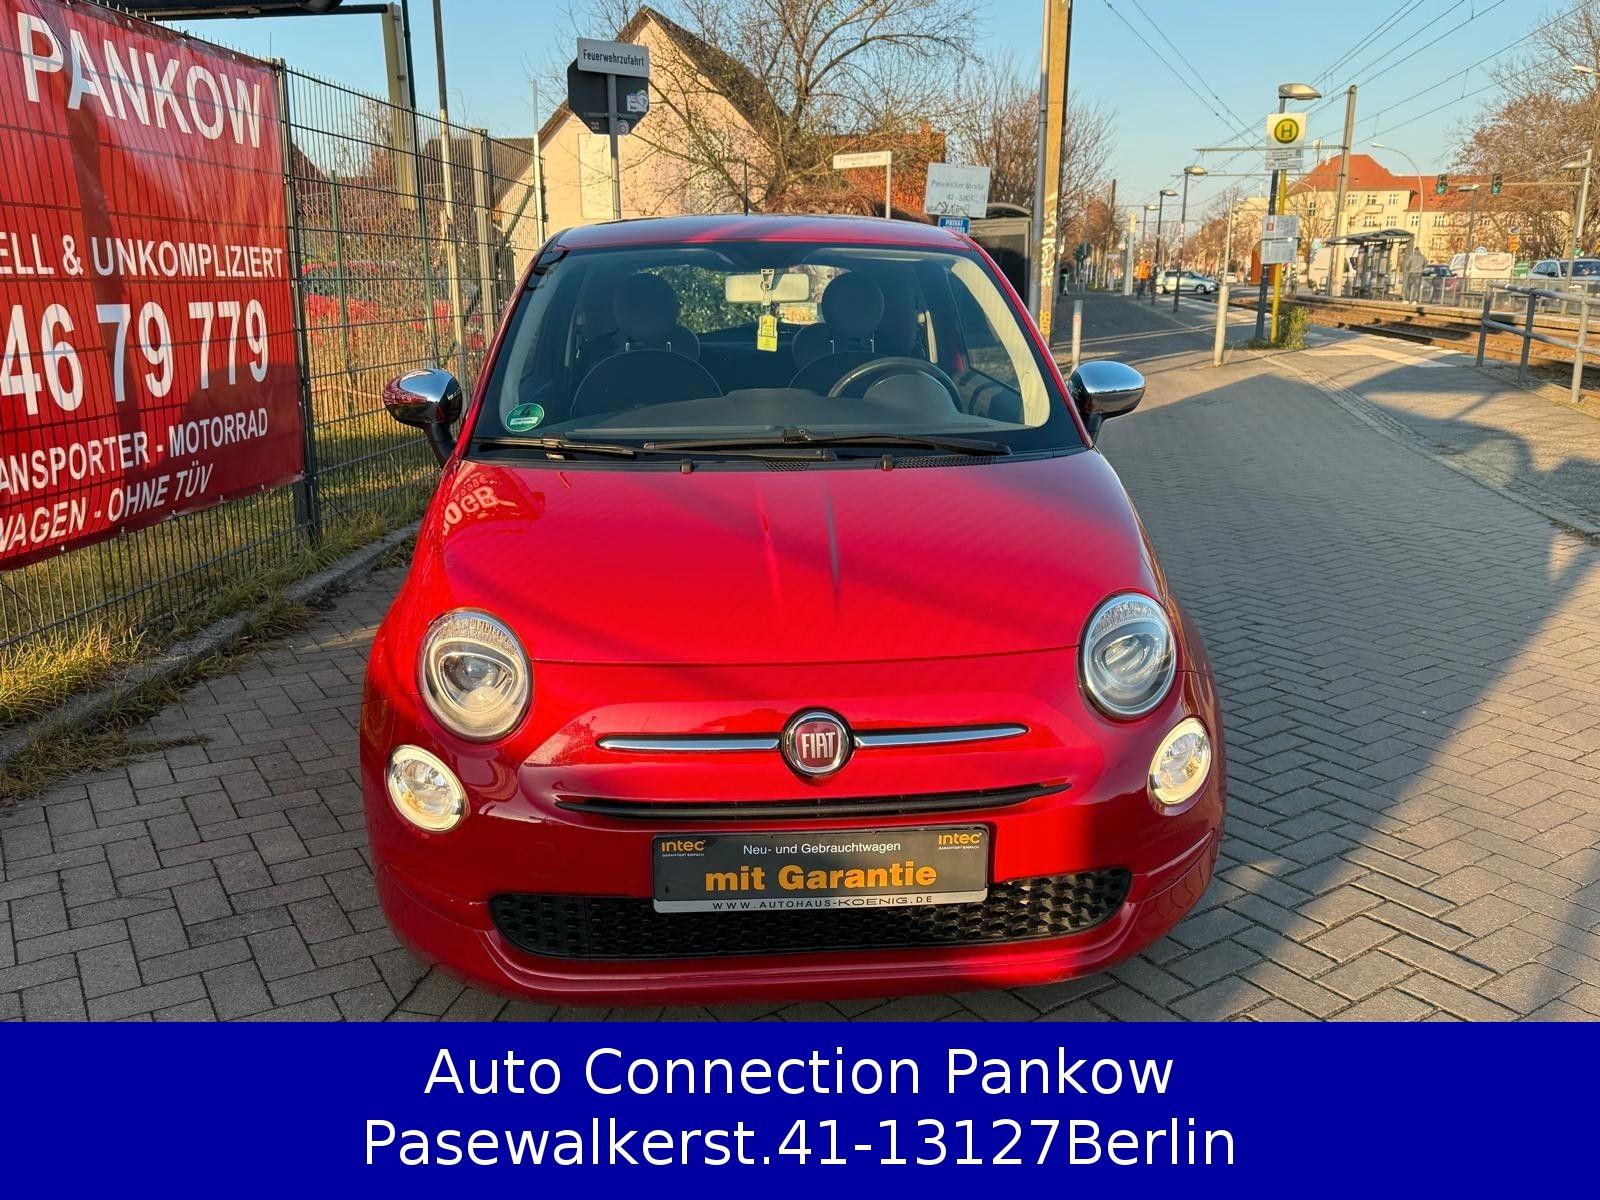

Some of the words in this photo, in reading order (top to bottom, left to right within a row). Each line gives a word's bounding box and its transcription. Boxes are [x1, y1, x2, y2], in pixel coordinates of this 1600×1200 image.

[583, 49, 644, 66] Feuerwehrzufahrt
[17, 12, 260, 148] PANKOW
[62, 234, 83, 275] &
[92, 236, 282, 278] UNKOMPLIZIERT
[0, 303, 84, 416] 46
[96, 301, 173, 402] 79
[188, 299, 268, 389] 779
[168, 408, 268, 458] MOTORRAD
[108, 475, 169, 521] OHNE
[175, 460, 213, 500] TÜV
[802, 732, 835, 758] FIAT
[661, 839, 705, 852] intec
[743, 845, 772, 855] Neu-
[775, 844, 797, 854] und
[801, 842, 901, 854] Gebrauchtwagen
[939, 833, 980, 845] intec
[705, 866, 765, 891] mit
[778, 861, 937, 890] Garantie
